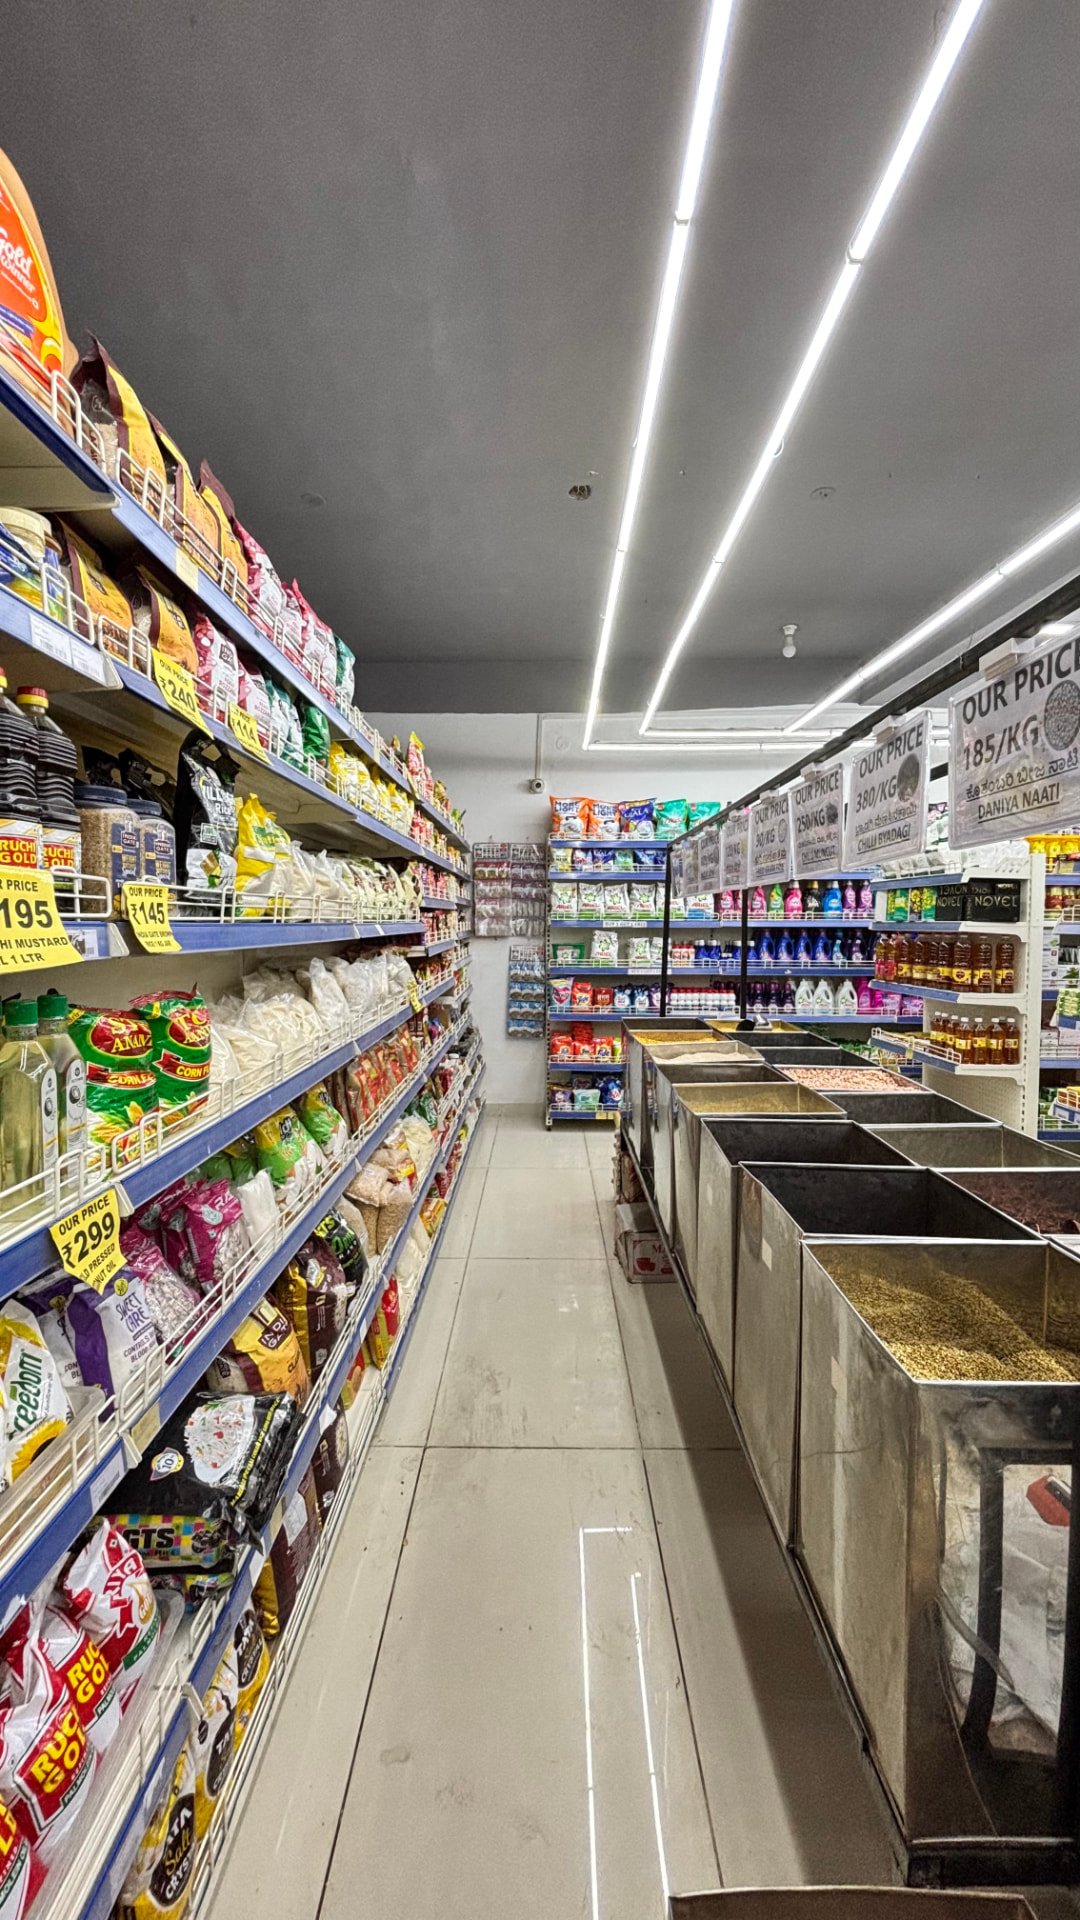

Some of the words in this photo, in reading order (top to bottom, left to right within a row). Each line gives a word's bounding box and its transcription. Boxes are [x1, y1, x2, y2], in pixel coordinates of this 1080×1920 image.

[962, 679, 1008, 725] OUR
[860, 749, 883, 778] OUR
[887, 723, 923, 764] PRICE
[963, 714, 1040, 771] 185/KG
[795, 785, 813, 805] OUR
[815, 770, 839, 798] PRICE
[856, 775, 897, 813] 380/KG
[978, 791, 1020, 820] DANIYA
[1022, 782, 1060, 811] NAATI
[755, 807, 769, 825] OUR
[878, 823, 911, 846] BYADAGI
[0, 840, 37, 854] RUCHI
[0, 851, 37, 865] GOLD
[6, 879, 38, 892] PRICE
[129, 887, 143, 897] OUR
[145, 888, 163, 898] PRICE
[937, 896, 960, 907] NOVEL
[975, 896, 1018, 908] NOVEL
[130, 902, 165, 925] ₹145
[15, 936, 69, 950] MUSTARD
[20, 952, 44, 963] LTR
[176, 1065, 202, 1077] CORN
[59, 1214, 80, 1236] OUR
[82, 1195, 110, 1221] PRICE
[62, 1211, 115, 1269] ₹299
[88, 1243, 115, 1273] PRESSED
[105, 1260, 117, 1273] OIL
[125, 1307, 150, 1333] CARE
